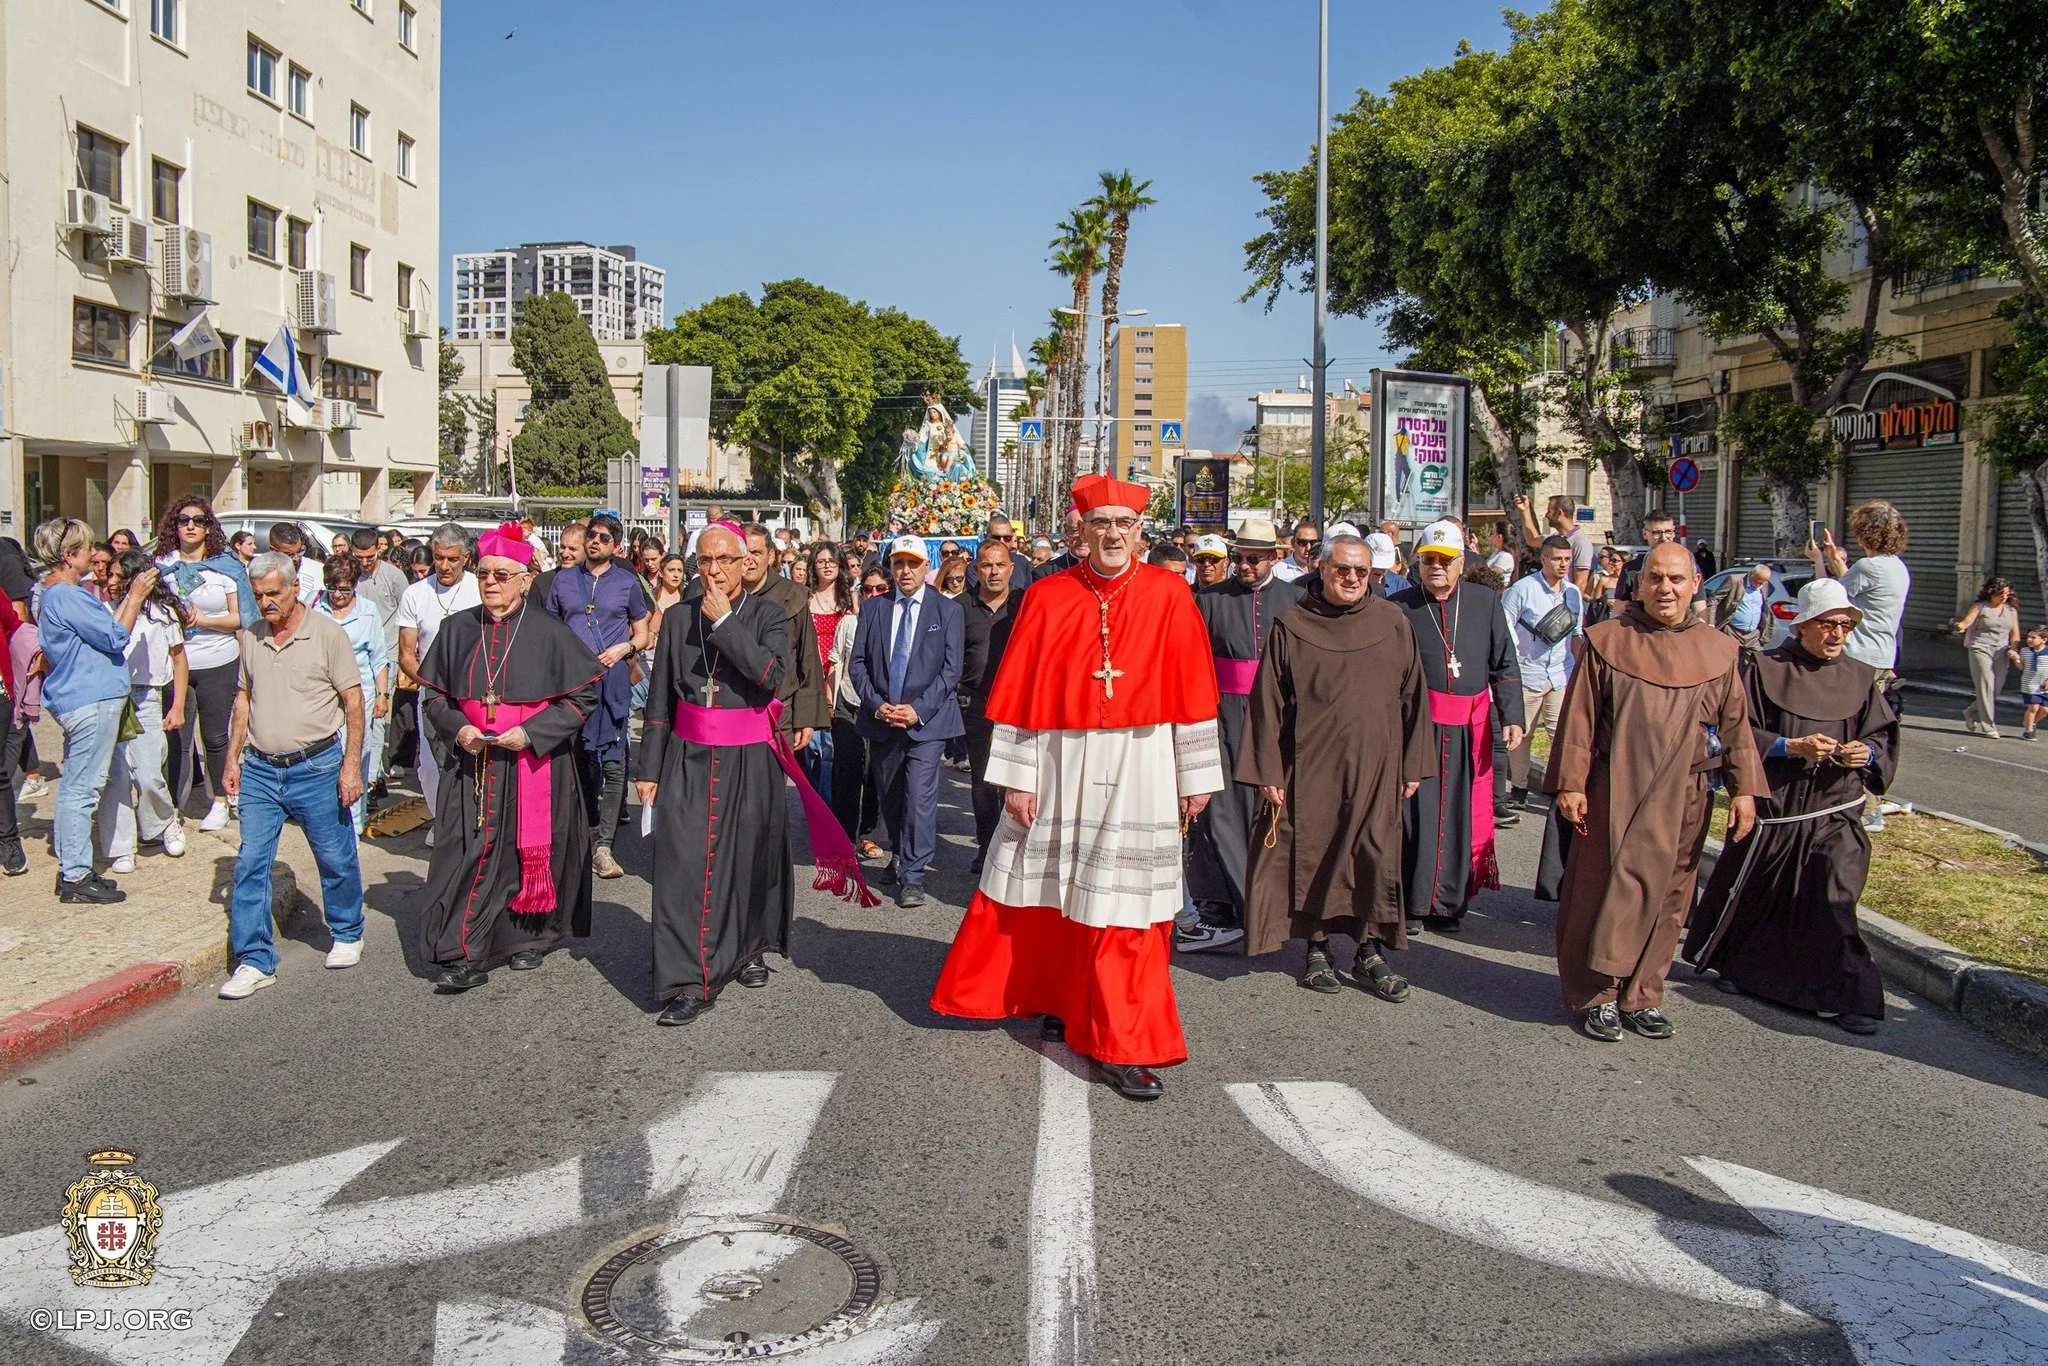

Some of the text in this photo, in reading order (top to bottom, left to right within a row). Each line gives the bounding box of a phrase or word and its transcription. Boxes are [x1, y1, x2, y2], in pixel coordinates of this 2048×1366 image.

[1396, 416, 1447, 433] על הסרת
[1880, 402, 1916, 443] חילוף
[1920, 397, 1954, 442] חלקי
[1411, 433, 1447, 448] השלט
[1414, 449, 1447, 465] כחוק!
